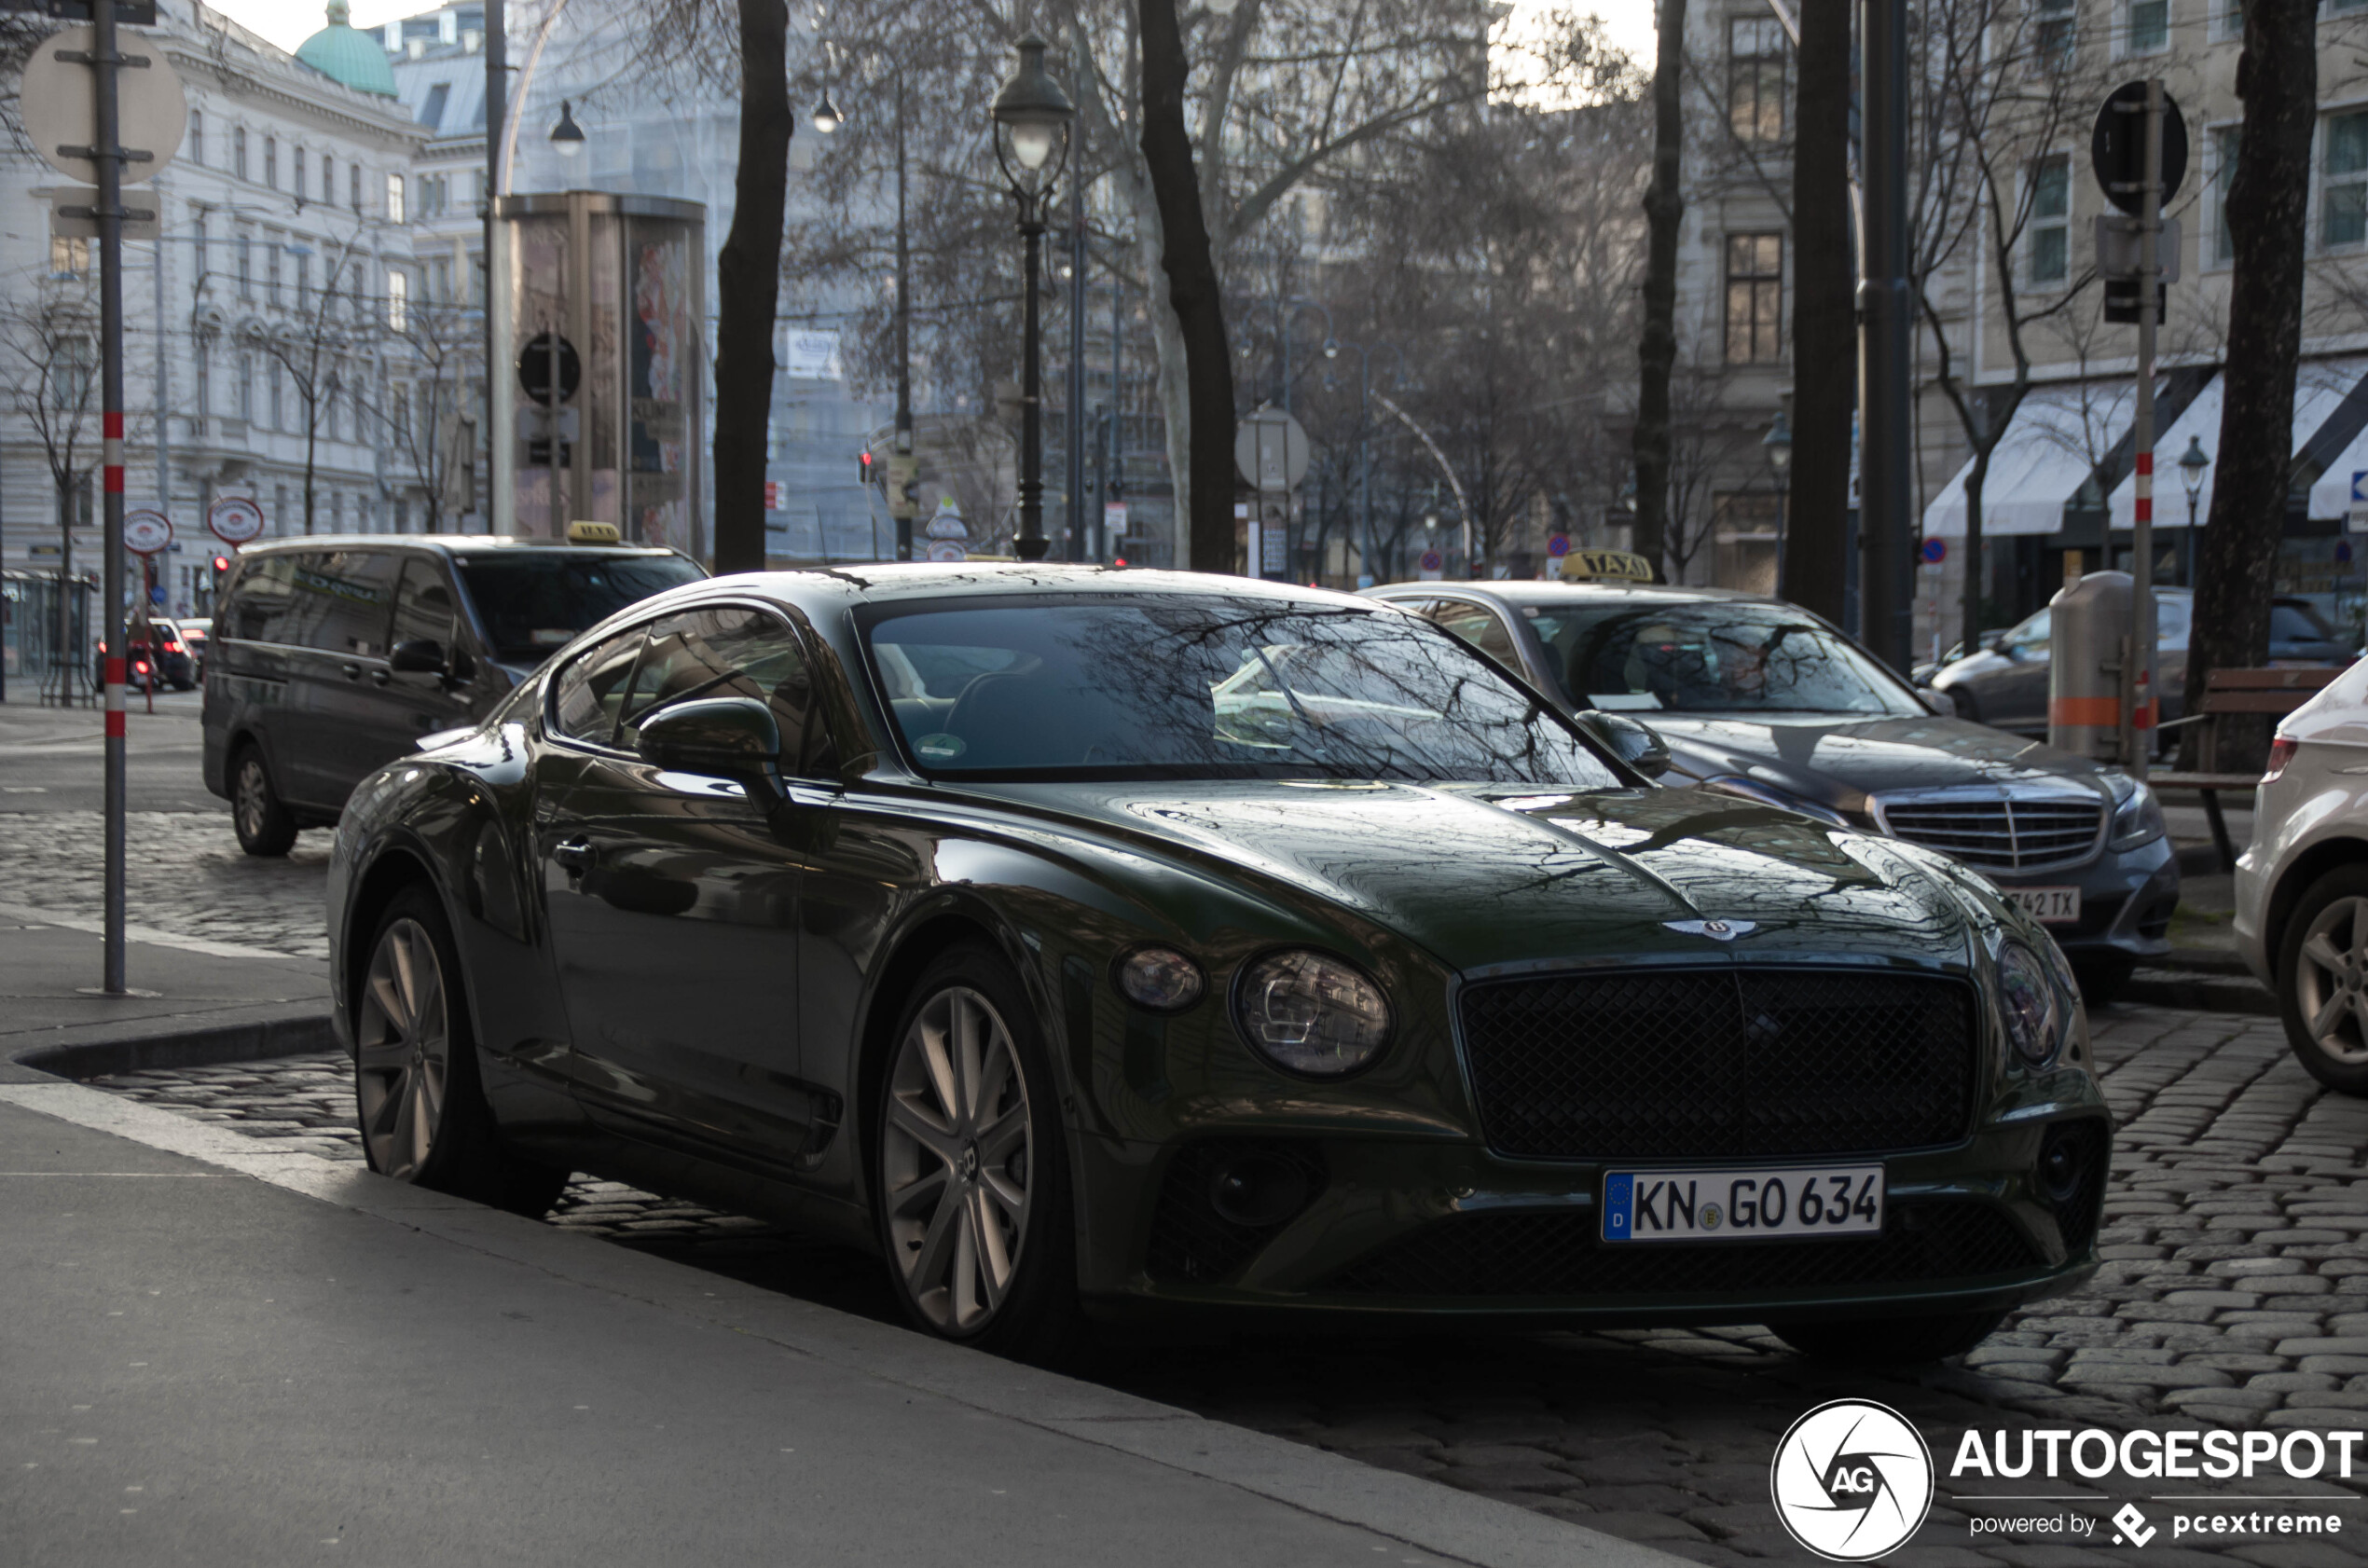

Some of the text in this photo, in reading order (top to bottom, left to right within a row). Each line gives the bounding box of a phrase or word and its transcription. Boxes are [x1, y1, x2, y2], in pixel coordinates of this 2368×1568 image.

[1582, 554, 1647, 577] TAXI
[2051, 892, 2073, 915] TX
[1634, 1175, 1877, 1231] KN GO 634
[1613, 1213, 1624, 1228] D
